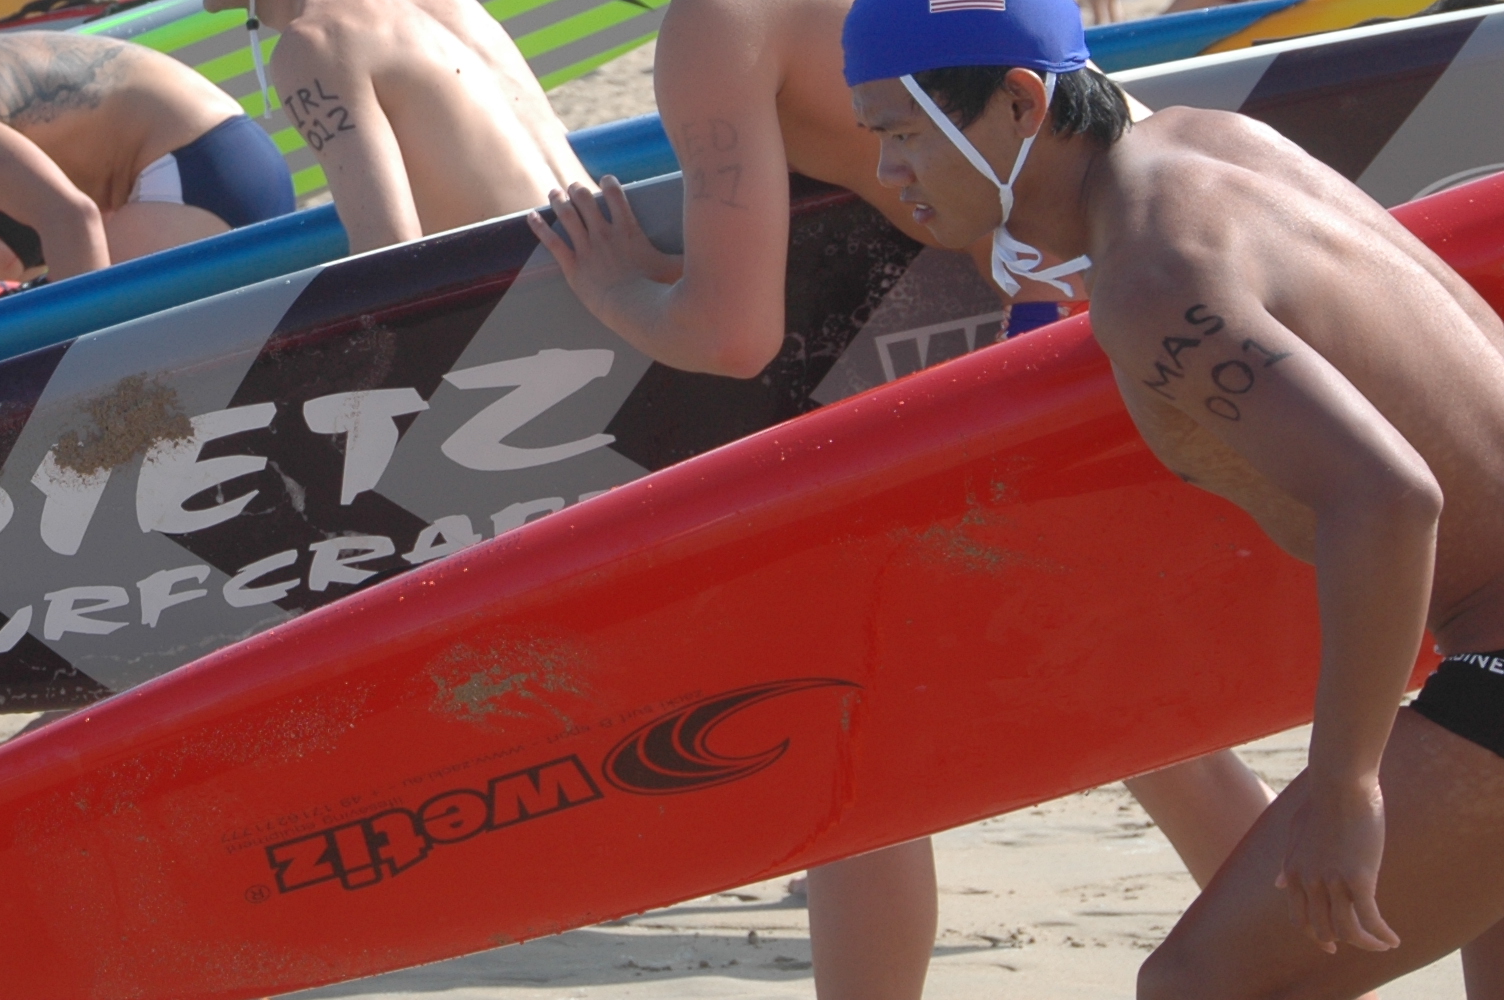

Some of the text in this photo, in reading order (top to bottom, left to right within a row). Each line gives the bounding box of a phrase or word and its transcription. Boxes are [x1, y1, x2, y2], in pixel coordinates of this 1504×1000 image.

[284, 78, 339, 129] IRL
[307, 106, 356, 152] 012
[1142, 303, 1226, 401] MAS
[1205, 338, 1293, 422] 001
[224, 796, 404, 855] lifesaving equipment
[264, 753, 605, 894] wetiz
